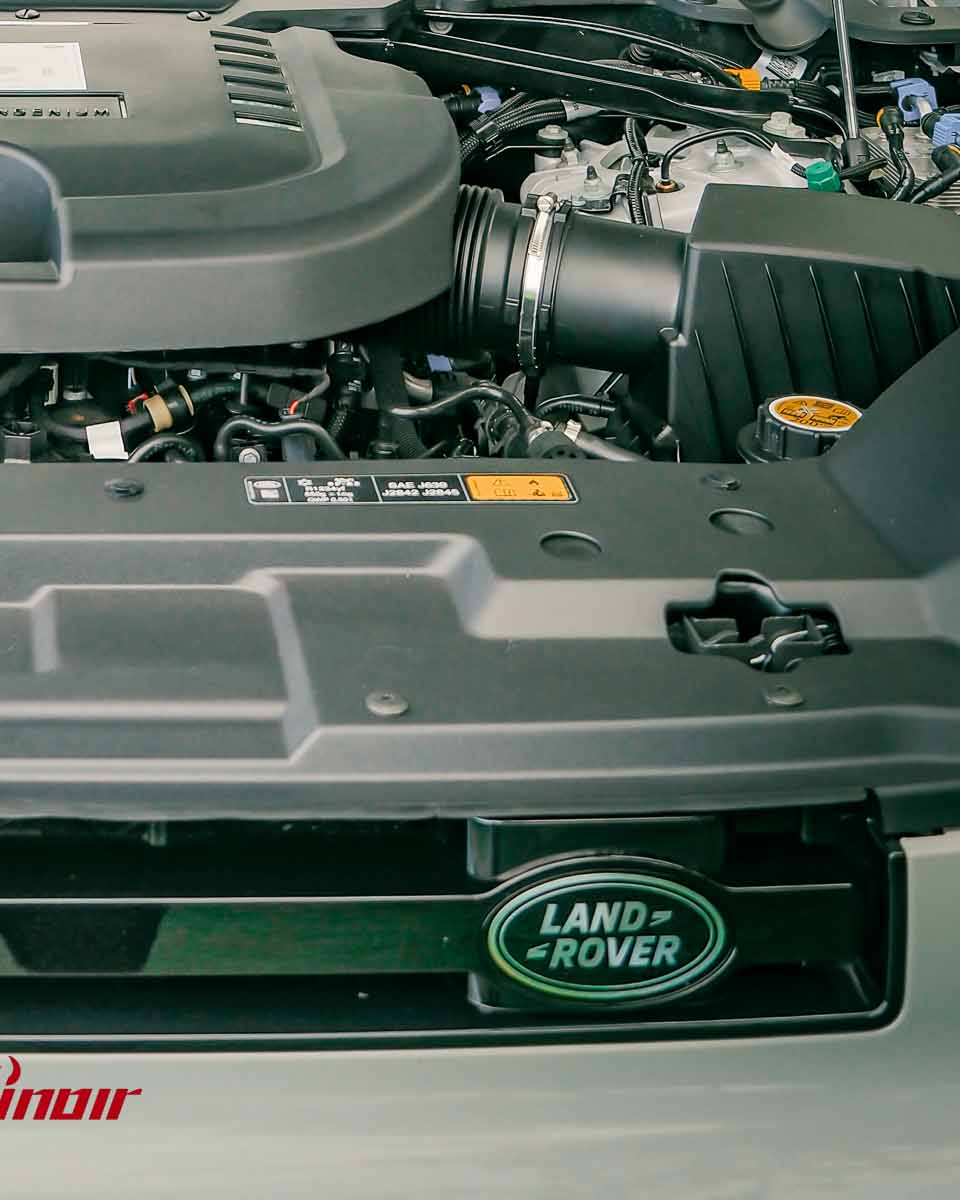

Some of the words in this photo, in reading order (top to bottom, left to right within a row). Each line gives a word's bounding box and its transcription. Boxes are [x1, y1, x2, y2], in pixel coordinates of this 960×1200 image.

[387, 481, 416, 489] SAE
[539, 901, 647, 935] LAND
[548, 934, 682, 969] ROVER
